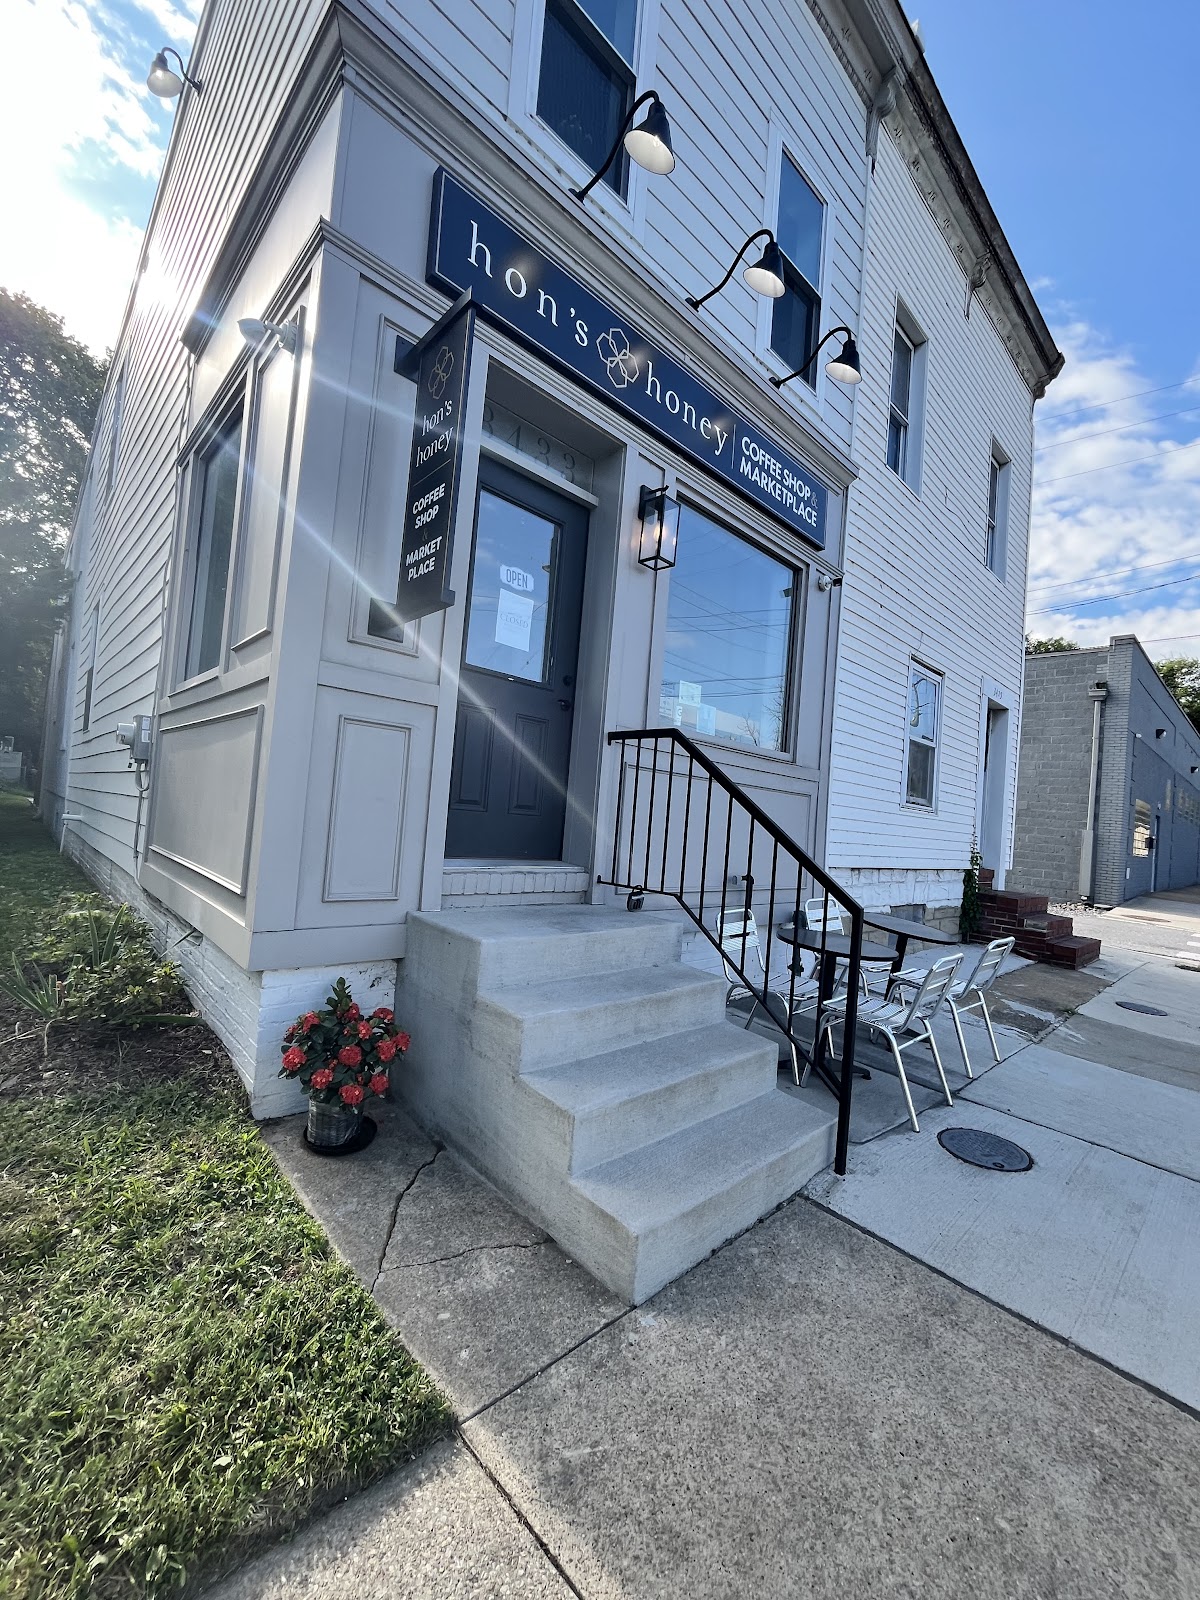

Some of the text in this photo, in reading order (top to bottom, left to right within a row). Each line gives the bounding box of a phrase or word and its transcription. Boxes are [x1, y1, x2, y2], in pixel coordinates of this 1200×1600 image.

[467, 220, 729, 456] hon's honey
[422, 400, 453, 437] hon's
[415, 426, 454, 468] honey
[741, 436, 819, 509] COFFEE SHOP &
[412, 483, 446, 515] COFFEE
[739, 456, 818, 528] MARKETPLACE
[414, 504, 440, 529] SHOP
[405, 536, 443, 567] MARKET
[407, 557, 436, 582] PLACE
[506, 568, 528, 589] OPEN
